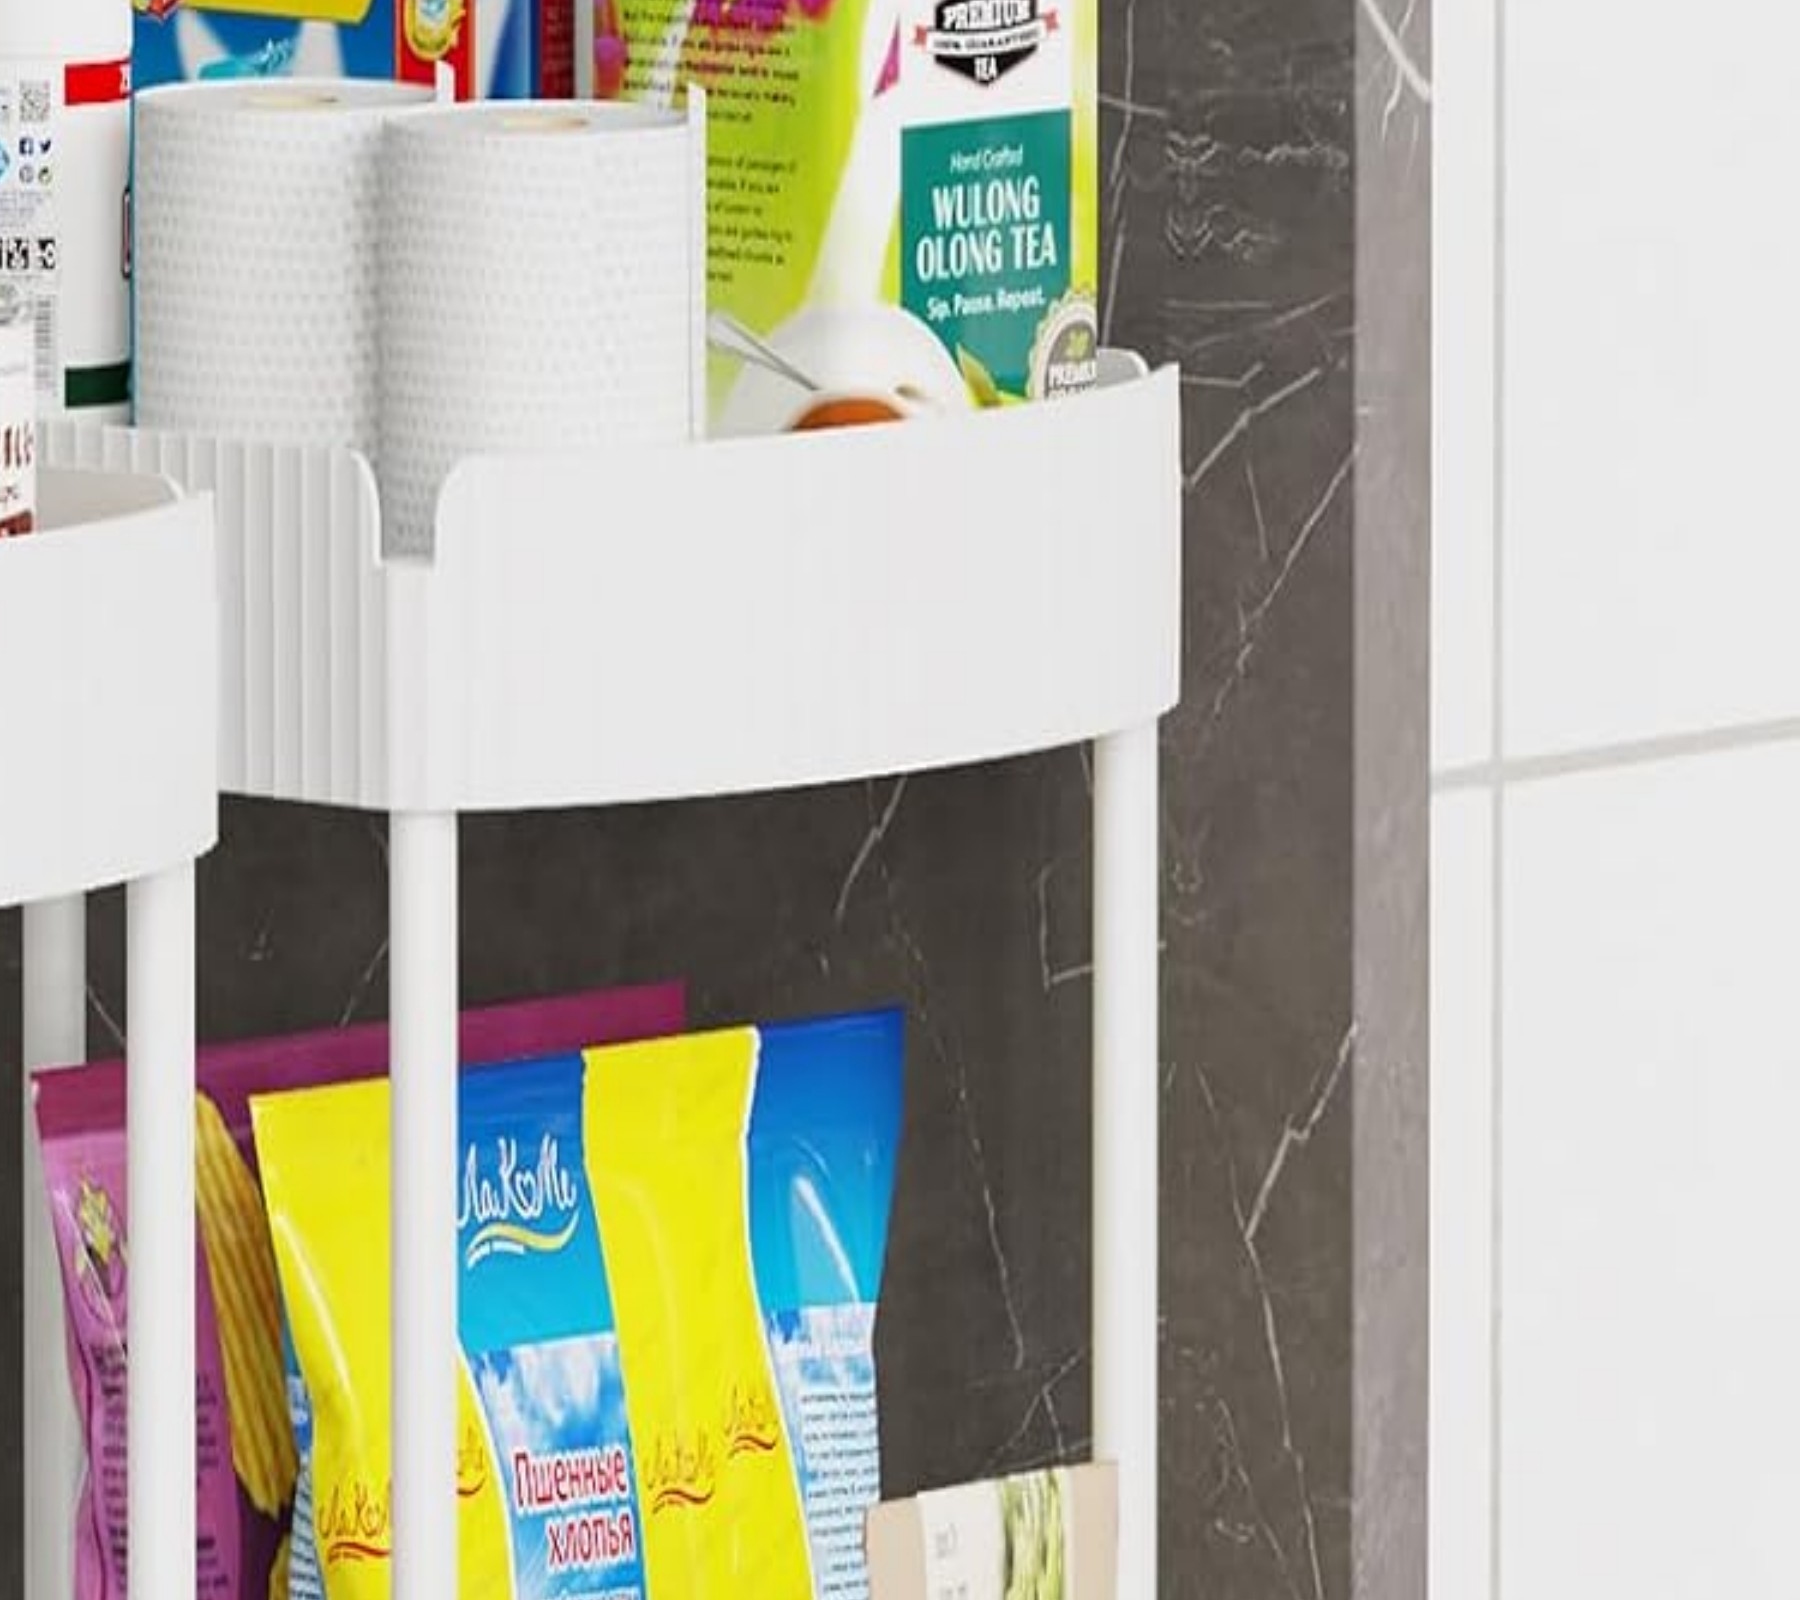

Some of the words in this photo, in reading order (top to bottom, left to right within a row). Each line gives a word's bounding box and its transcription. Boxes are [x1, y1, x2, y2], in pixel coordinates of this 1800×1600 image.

[973, 54, 998, 82] TEA
[931, 174, 1041, 230] WULONG
[915, 229, 1003, 283] OLONG
[1009, 220, 1058, 271] TEA
[513, 1448, 629, 1509] Пшенные
